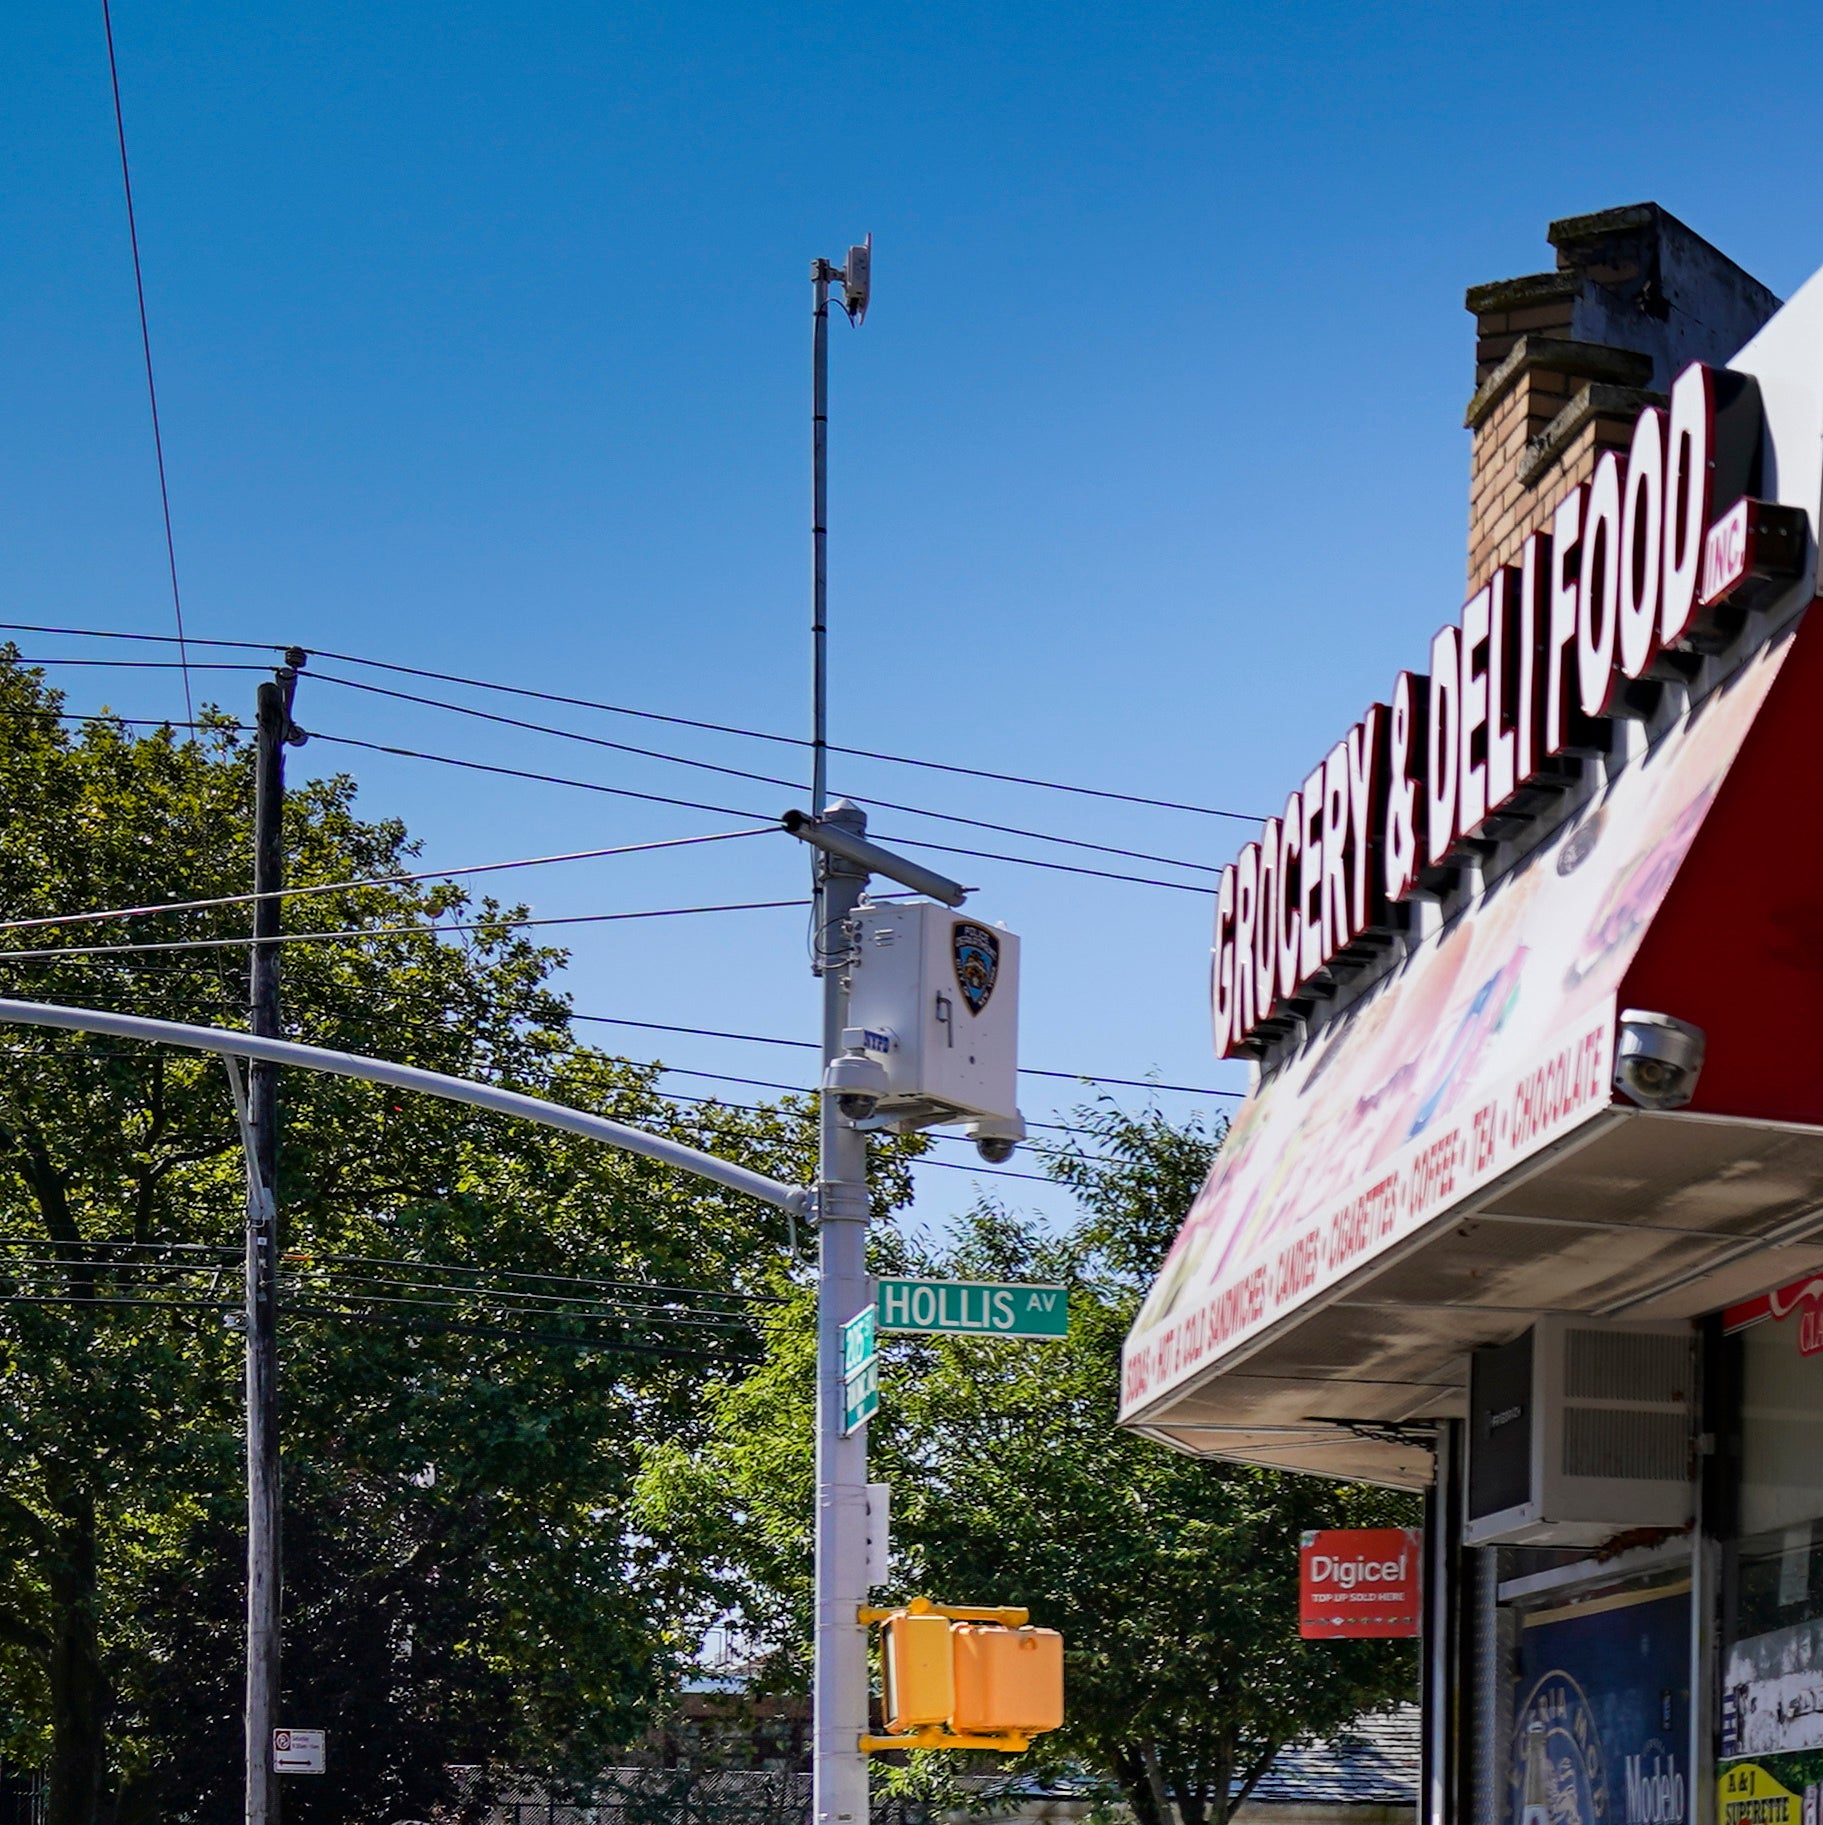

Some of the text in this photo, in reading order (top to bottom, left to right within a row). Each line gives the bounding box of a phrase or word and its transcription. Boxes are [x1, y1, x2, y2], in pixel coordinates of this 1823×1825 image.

[1212, 702, 1385, 1060] GROCERY
[1385, 670, 1421, 902] &
[1427, 528, 1546, 867] DELI
[1546, 360, 1712, 756] FOOD
[1208, 1263, 1266, 1350] SANDWICHES
[1276, 1227, 1320, 1307] CANDIES
[1328, 1170, 1398, 1271] CIGARETTES
[1410, 1127, 1460, 1218] COFFEE
[1470, 1100, 1497, 1178] TEA
[1512, 1024, 1605, 1150] CHOCOLATE
[885, 1285, 1057, 1329] HOLLIS AV
[1311, 1554, 1408, 1589] Digicel
[1311, 1592, 1405, 1602] TOP UP SOLD HERE
[1727, 1770, 1756, 1796] A & J
